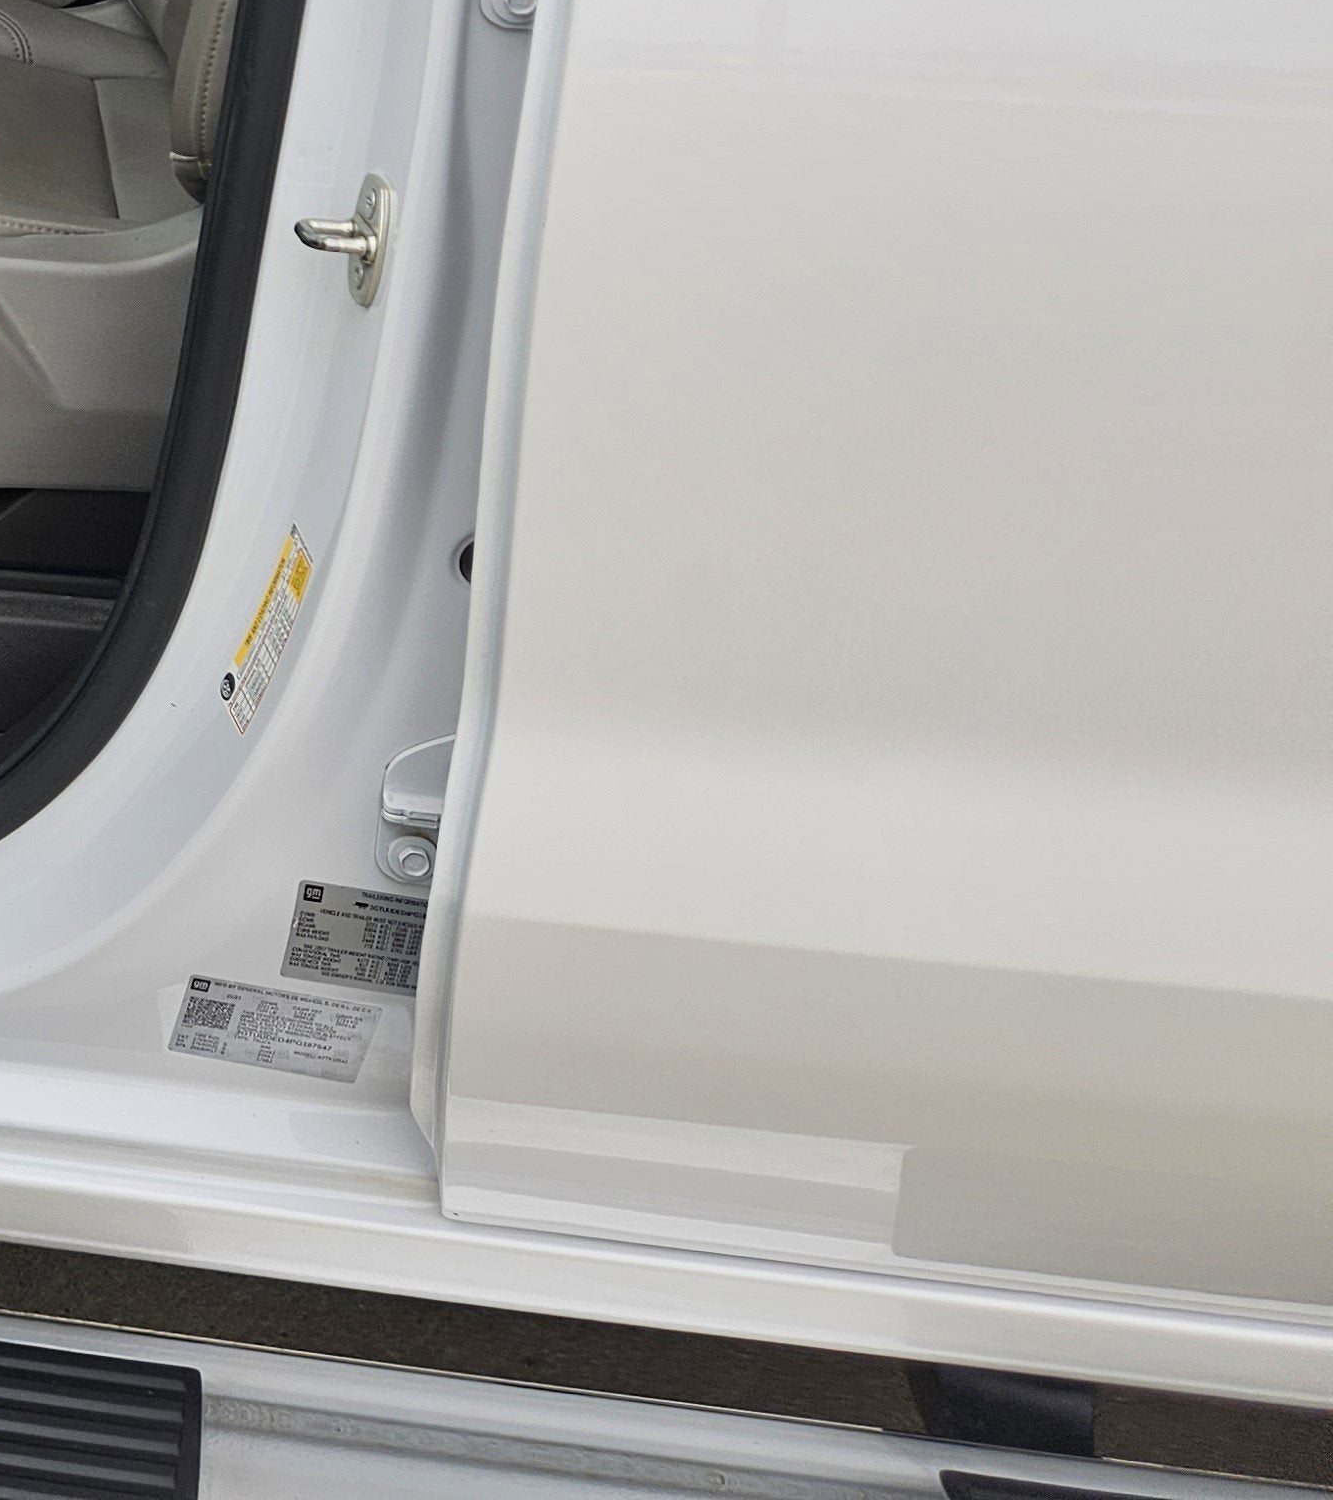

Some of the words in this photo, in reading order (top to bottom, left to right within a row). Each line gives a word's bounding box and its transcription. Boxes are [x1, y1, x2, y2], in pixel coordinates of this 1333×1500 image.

[305, 886, 323, 900] gm
[320, 908, 340, 917] VEHICLE
[352, 913, 372, 922] TRAILER
[307, 934, 329, 942] PAYLOAD
[327, 946, 348, 955] TRAILER
[192, 979, 209, 991] gm
[237, 985, 264, 994] GENERAL
[264, 989, 290, 999] MOTORS
